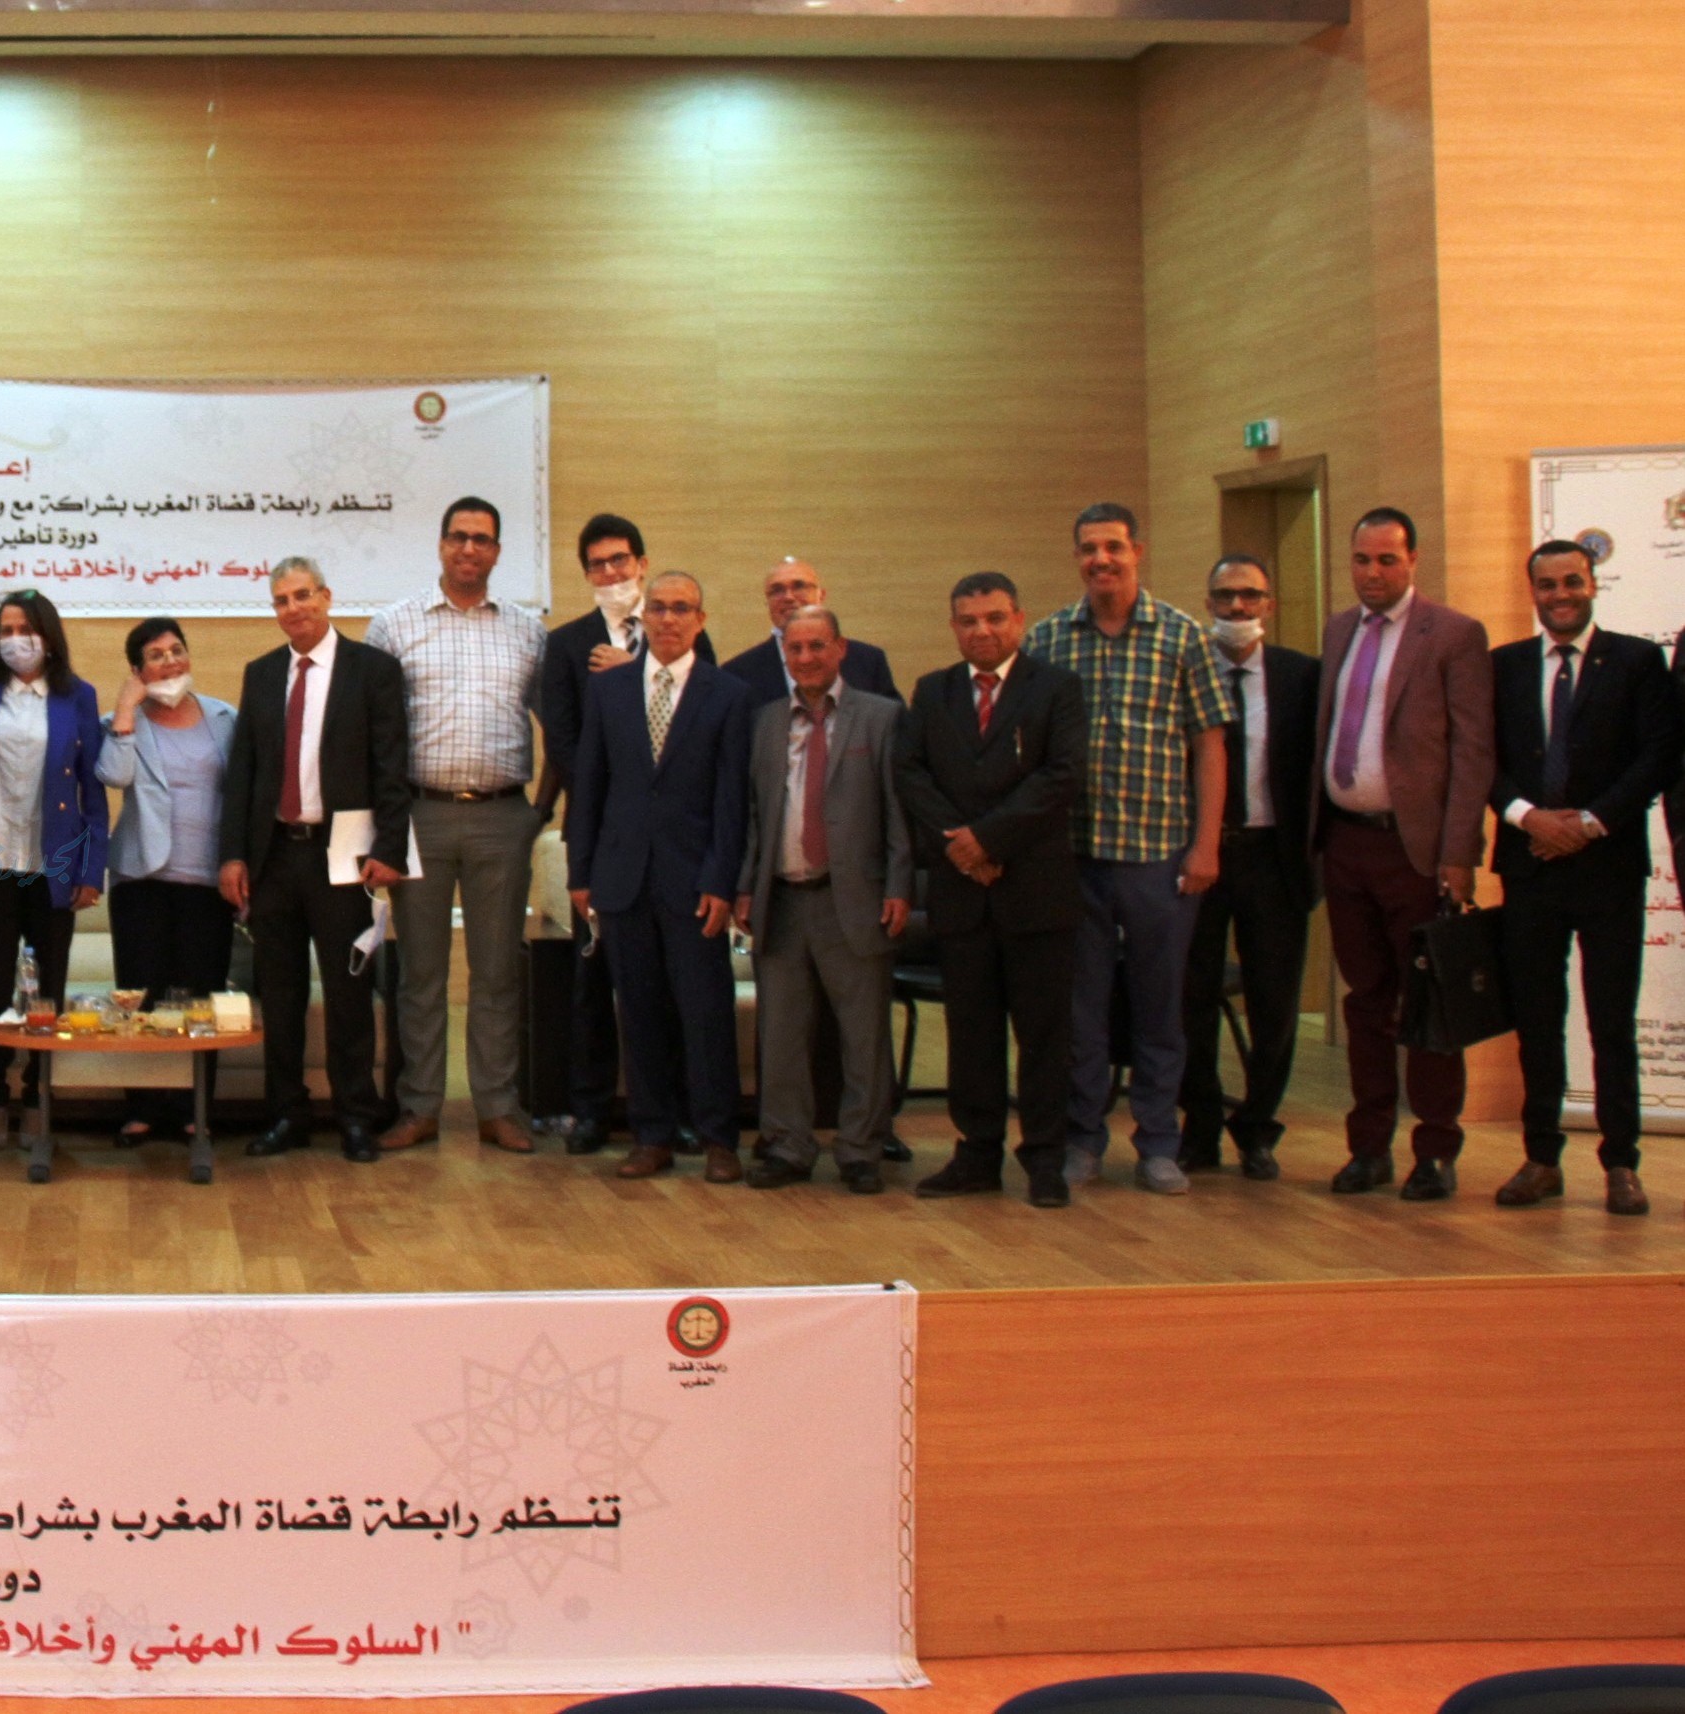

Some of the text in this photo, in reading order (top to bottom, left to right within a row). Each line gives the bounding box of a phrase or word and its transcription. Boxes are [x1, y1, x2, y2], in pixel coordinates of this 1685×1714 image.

[10, 501, 34, 520] مع
[40, 494, 128, 517] بشراكة
[133, 494, 200, 517] المغرب
[206, 493, 256, 512] قضاة
[261, 494, 321, 517] رابطة
[58, 528, 98, 550] دورة
[32, 557, 136, 582] وأخلاقيات
[142, 560, 209, 585] المهني
[680, 1376, 715, 1389] المغرب
[111, 1497, 242, 1542] المغرب
[255, 1495, 352, 1531] قضاة
[363, 1497, 480, 1541] رابطة
[491, 1494, 622, 1534] تنظم
[129, 1622, 260, 1672] المهني
[276, 1622, 439, 1665] السلوك
